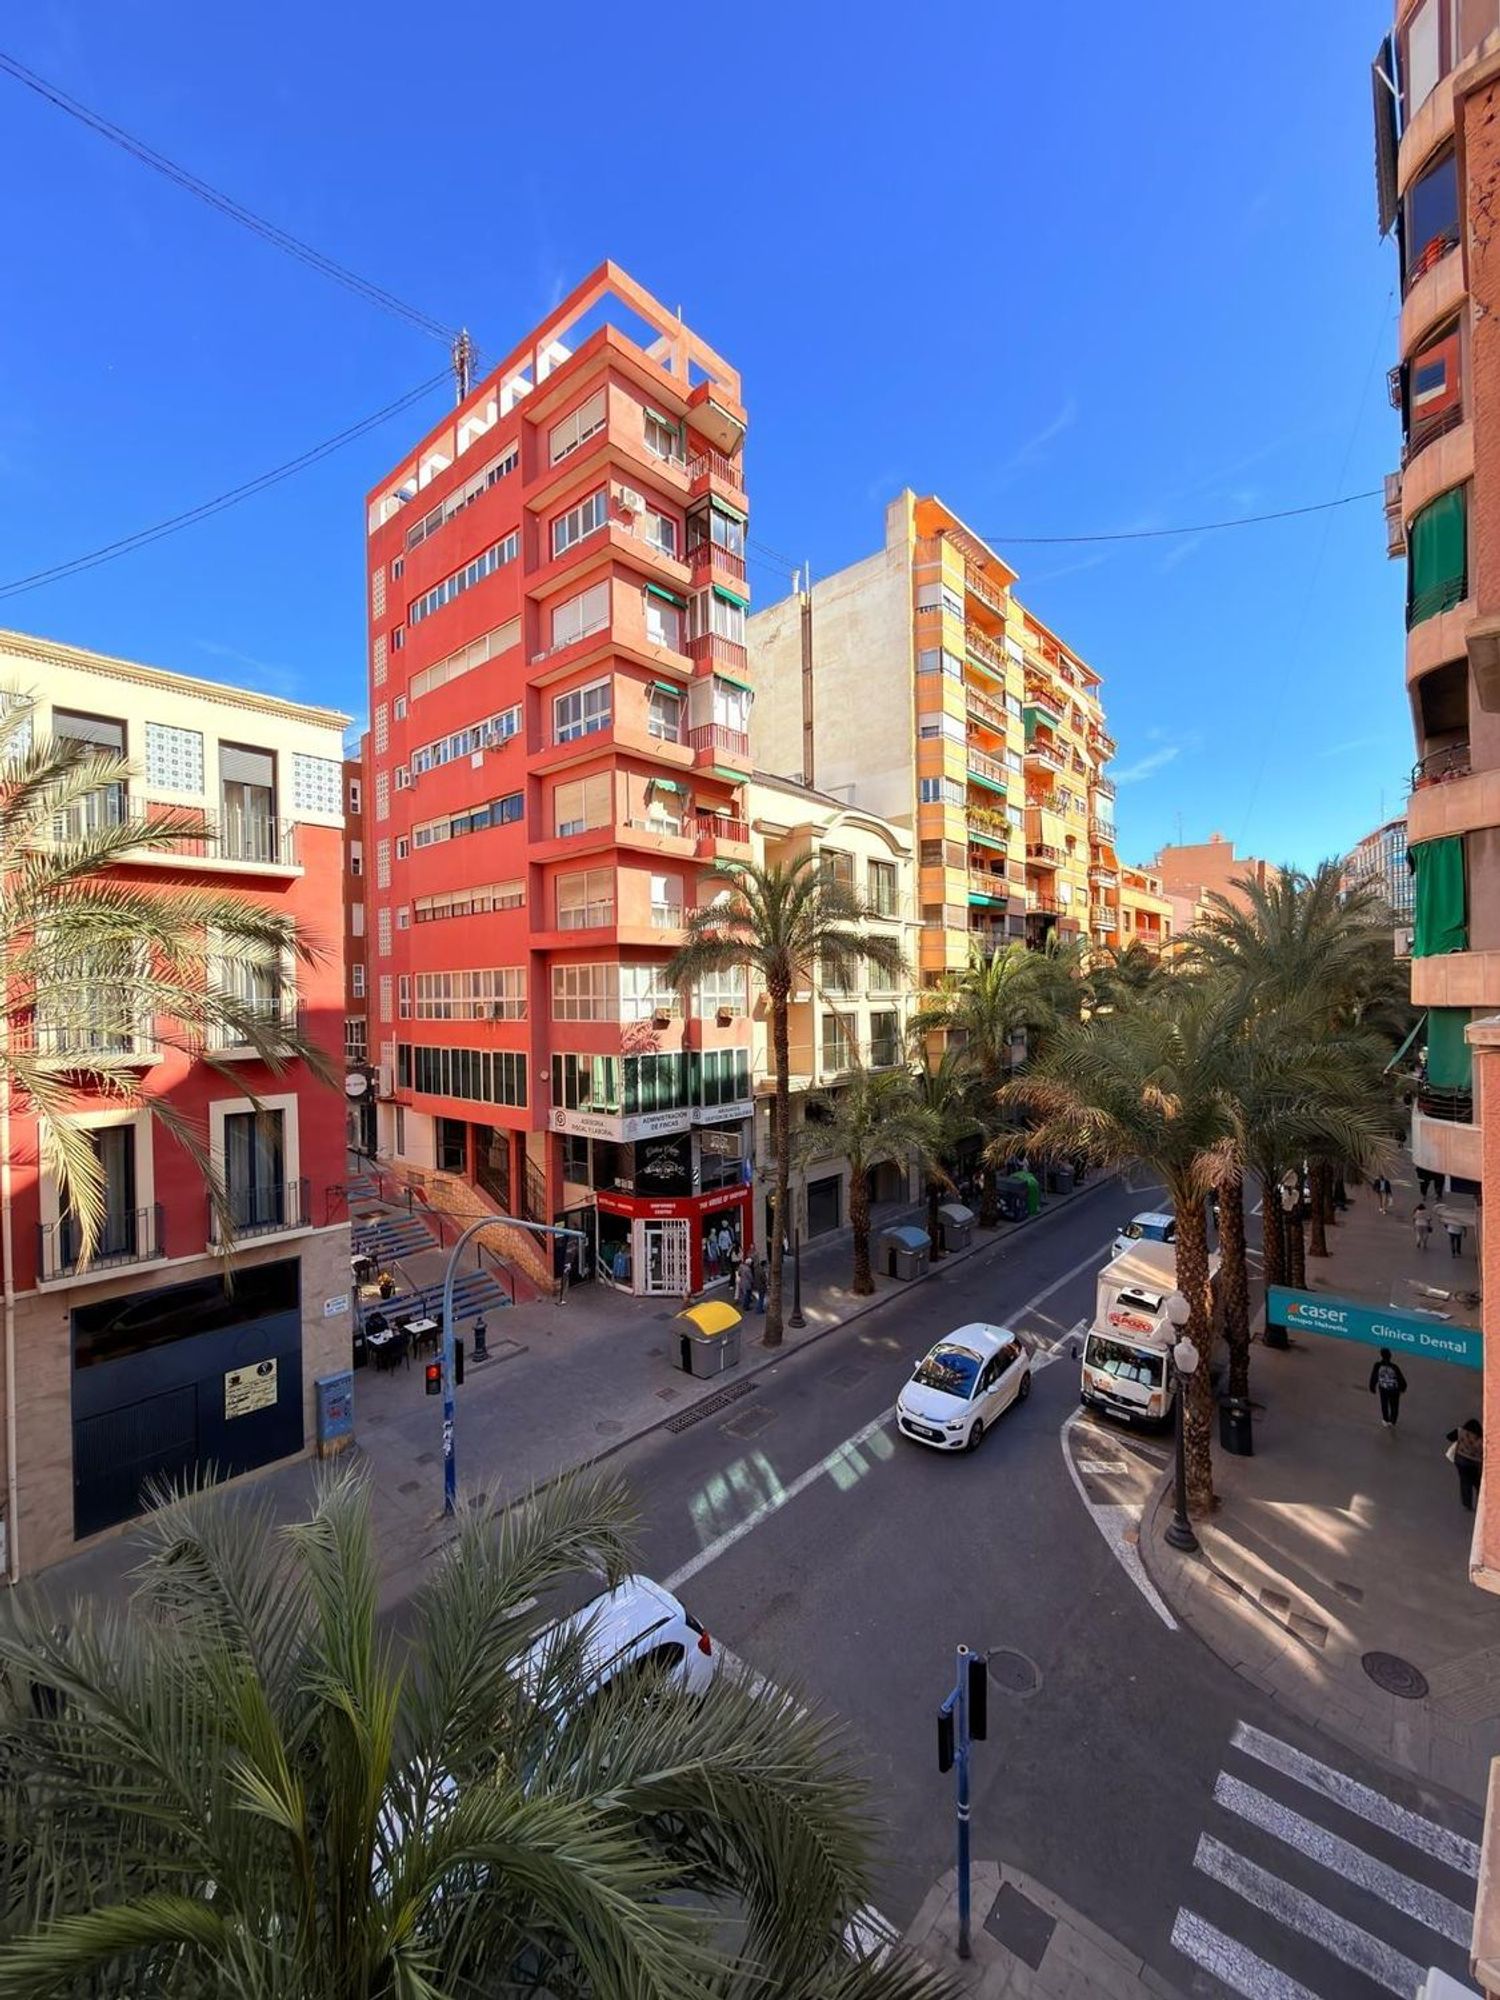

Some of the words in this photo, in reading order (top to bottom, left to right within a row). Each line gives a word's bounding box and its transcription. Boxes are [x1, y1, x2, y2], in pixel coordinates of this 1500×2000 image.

[650, 1122, 659, 1131] DE
[659, 1119, 679, 1129] FINCAS
[1287, 1314, 1313, 1326] Grupo
[1299, 1304, 1348, 1323] caser
[1370, 1324, 1415, 1342] Clínica
[1420, 1334, 1467, 1353] Dental
